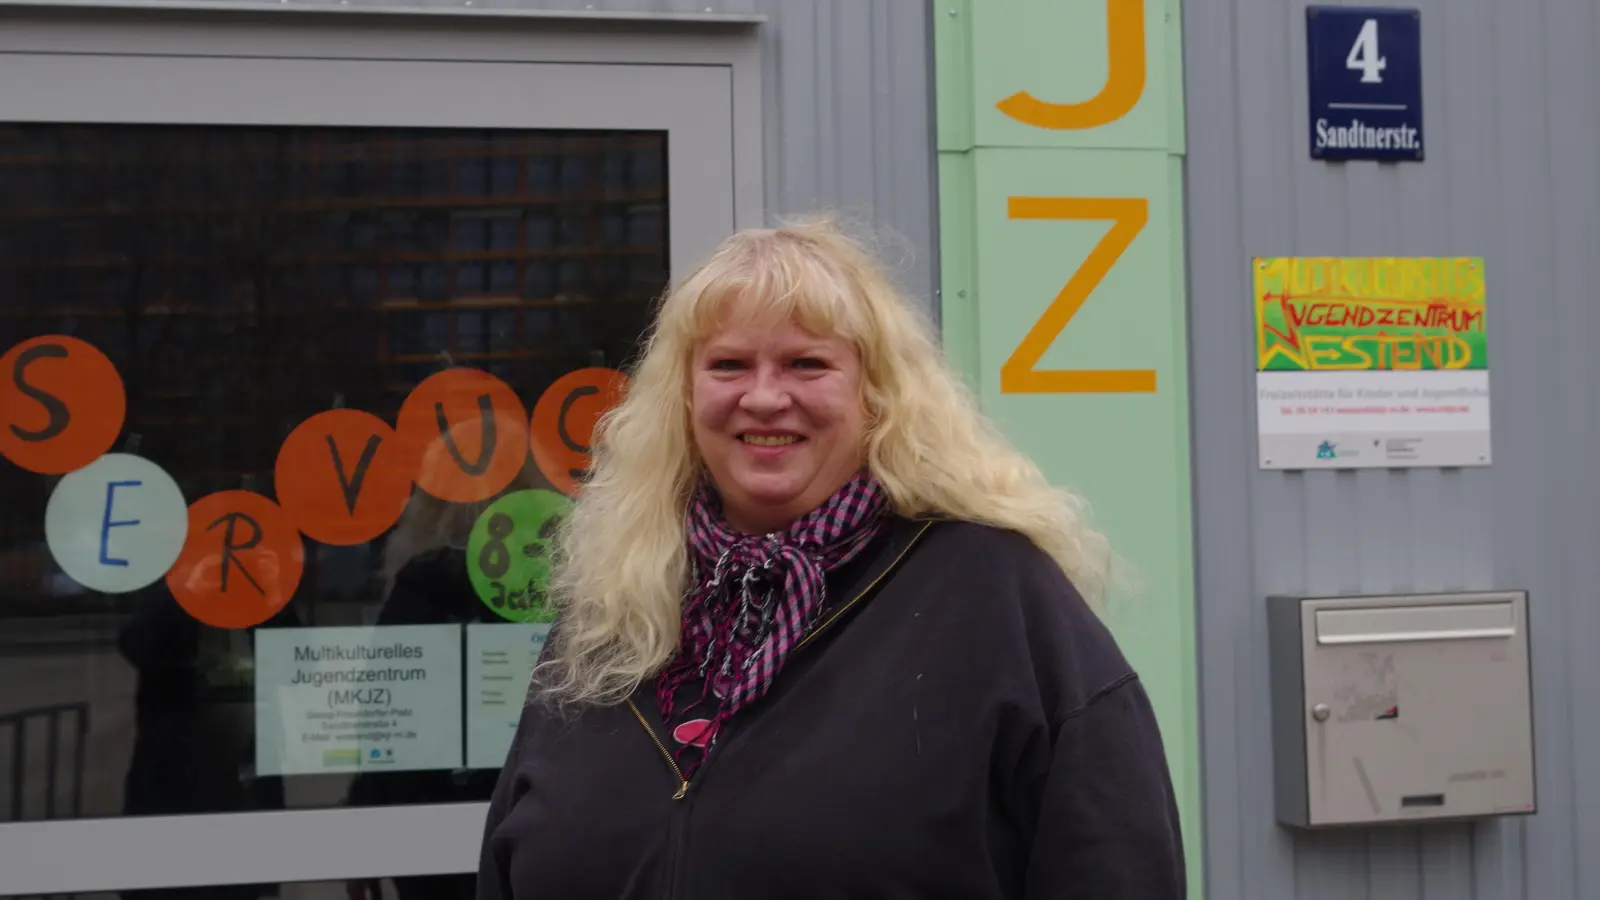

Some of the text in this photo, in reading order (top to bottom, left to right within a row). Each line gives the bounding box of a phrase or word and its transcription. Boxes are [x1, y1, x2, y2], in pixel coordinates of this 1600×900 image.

[1346, 18, 1387, 83] 4
[1316, 118, 1420, 149] Sandtnerstr.
[1257, 333, 1472, 370] WESTEND
[294, 643, 424, 662] Multikulturelles
[291, 665, 427, 688] Jugendzentrum
[327, 688, 392, 708] (MKJZ)
